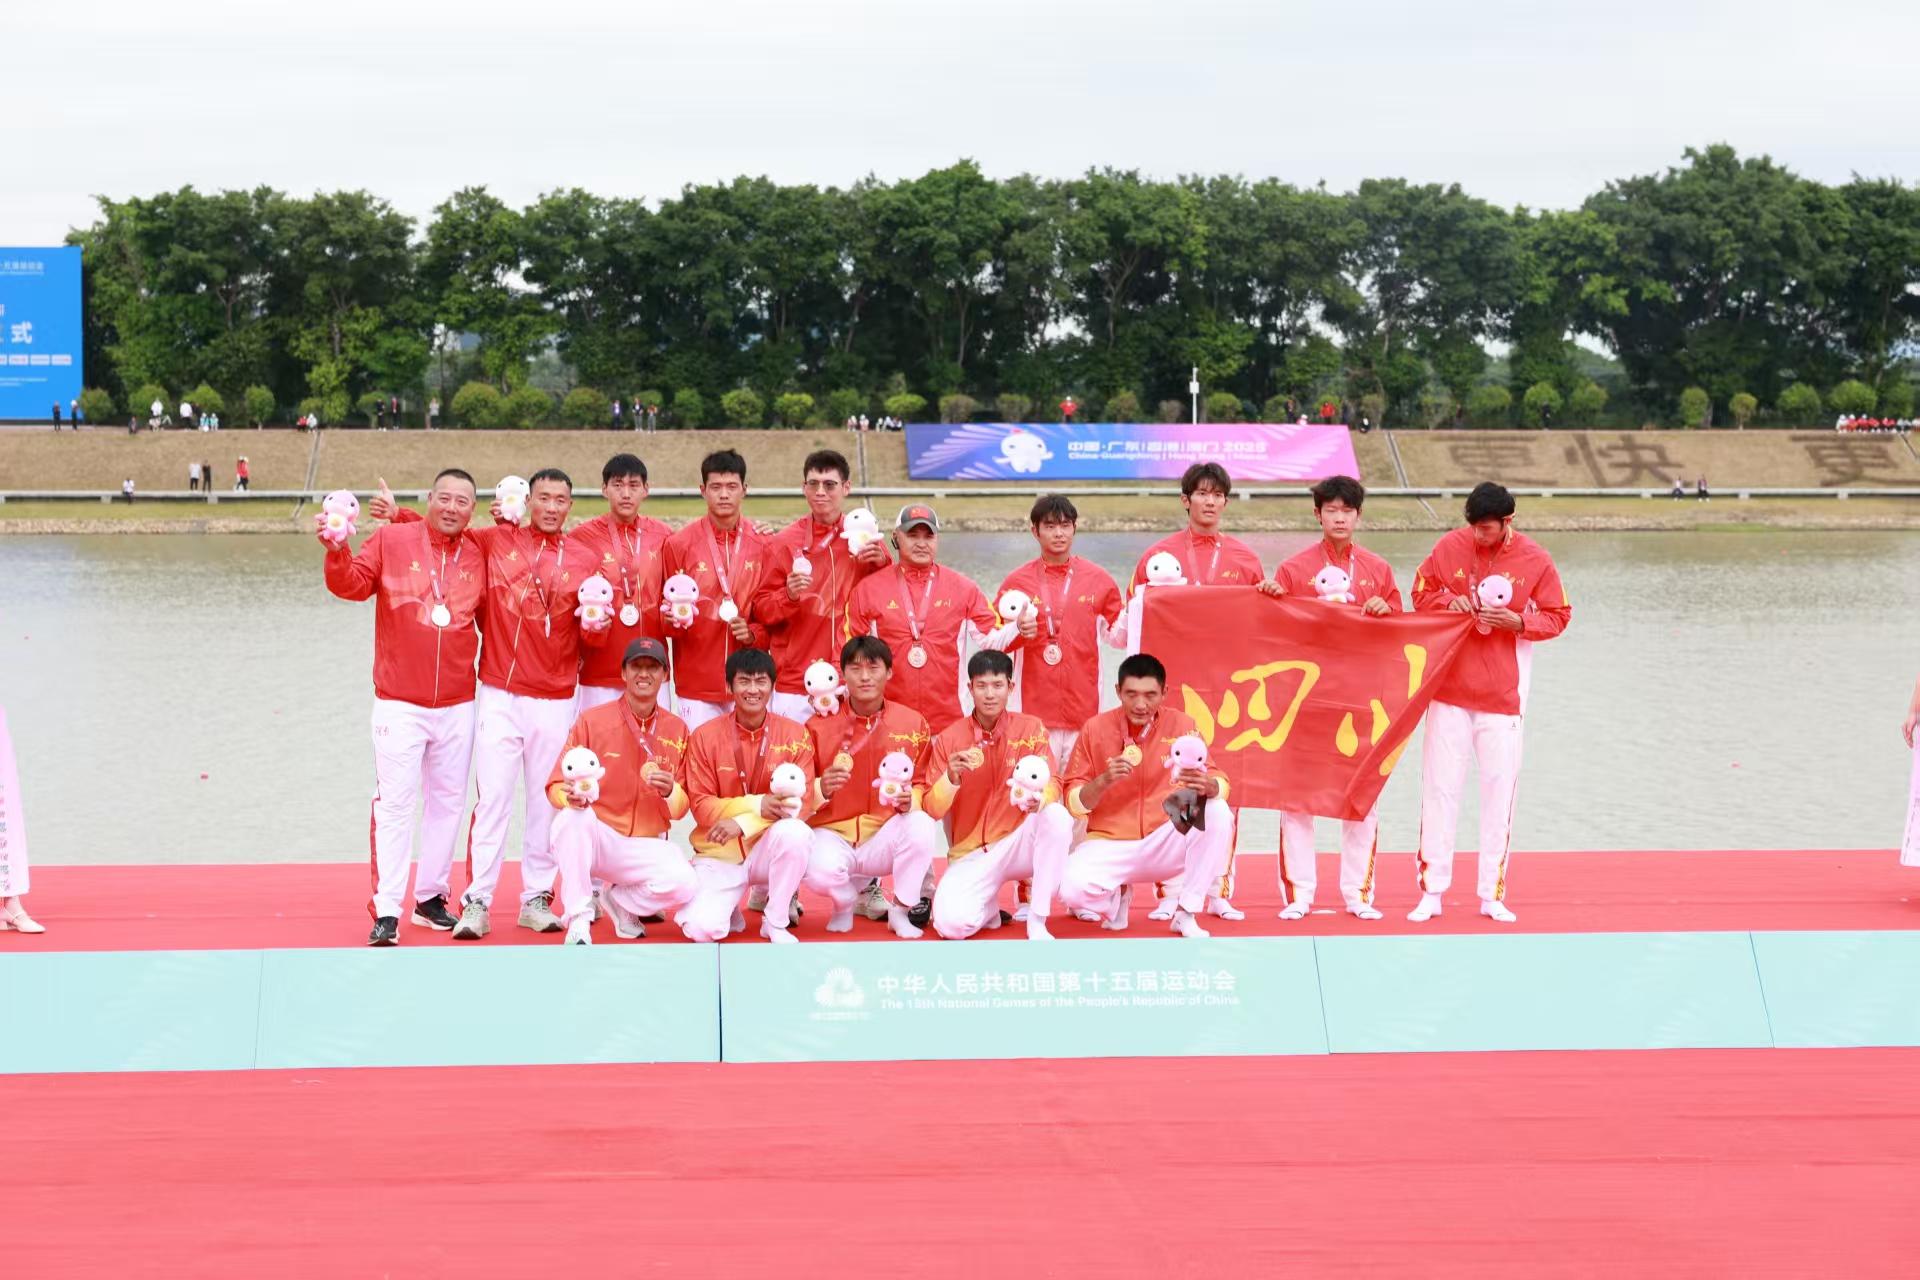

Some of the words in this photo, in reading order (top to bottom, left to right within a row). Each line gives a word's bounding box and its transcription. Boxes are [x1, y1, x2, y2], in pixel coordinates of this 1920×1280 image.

[11, 321, 32, 344] 式
[877, 969, 1237, 994] 中华人民共和国第十五届运动会
[880, 998, 904, 1009] The
[909, 998, 935, 1009] 15th
[938, 998, 990, 1009] National
[992, 997, 1036, 1008] Games
[1039, 997, 1051, 1007] of
[1055, 996, 1074, 1007] the
[1132, 994, 1185, 1007] Republic
[1188, 994, 1201, 1005] of
[1204, 994, 1240, 1005] China
